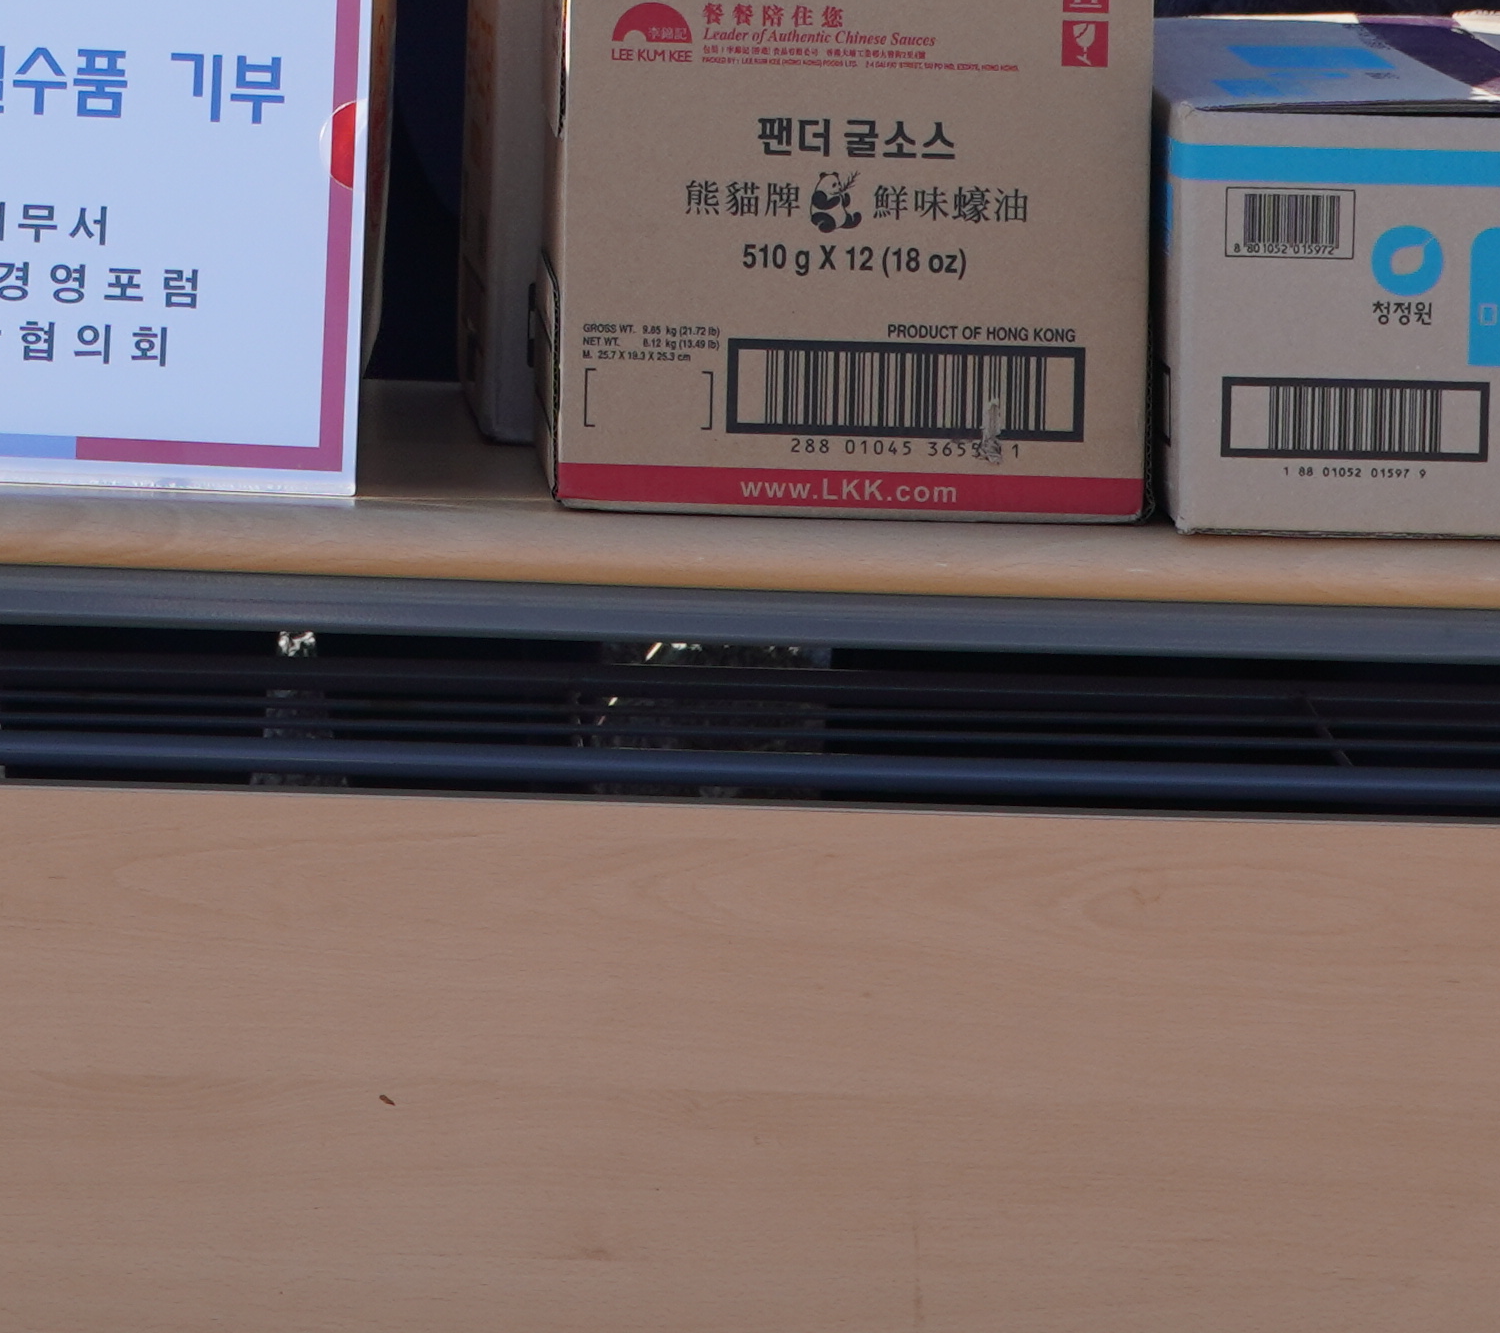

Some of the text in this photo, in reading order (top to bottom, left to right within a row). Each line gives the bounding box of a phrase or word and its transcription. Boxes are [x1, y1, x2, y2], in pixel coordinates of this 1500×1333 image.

[703, 28, 936, 48] Leader Authentic Chinese Sauces
[611, 48, 634, 61] LEE
[637, 49, 666, 62] KUM
[668, 50, 693, 63] KEE
[170, 51, 285, 125] 기부
[757, 117, 956, 160] 팬더 굴소스
[685, 180, 1029, 224] 熊貓牌 鮮味蠔油
[742, 244, 967, 280] 510 12 (18 oz)
[1372, 302, 1433, 326] 청정원
[583, 324, 617, 334] GROSS
[887, 324, 1076, 343] PRODUCT OF HONG KONG
[790, 437, 912, 457] 288 01045
[1322, 467, 1410, 479] 01052 01597
[741, 477, 958, 504] www.LKK.com
